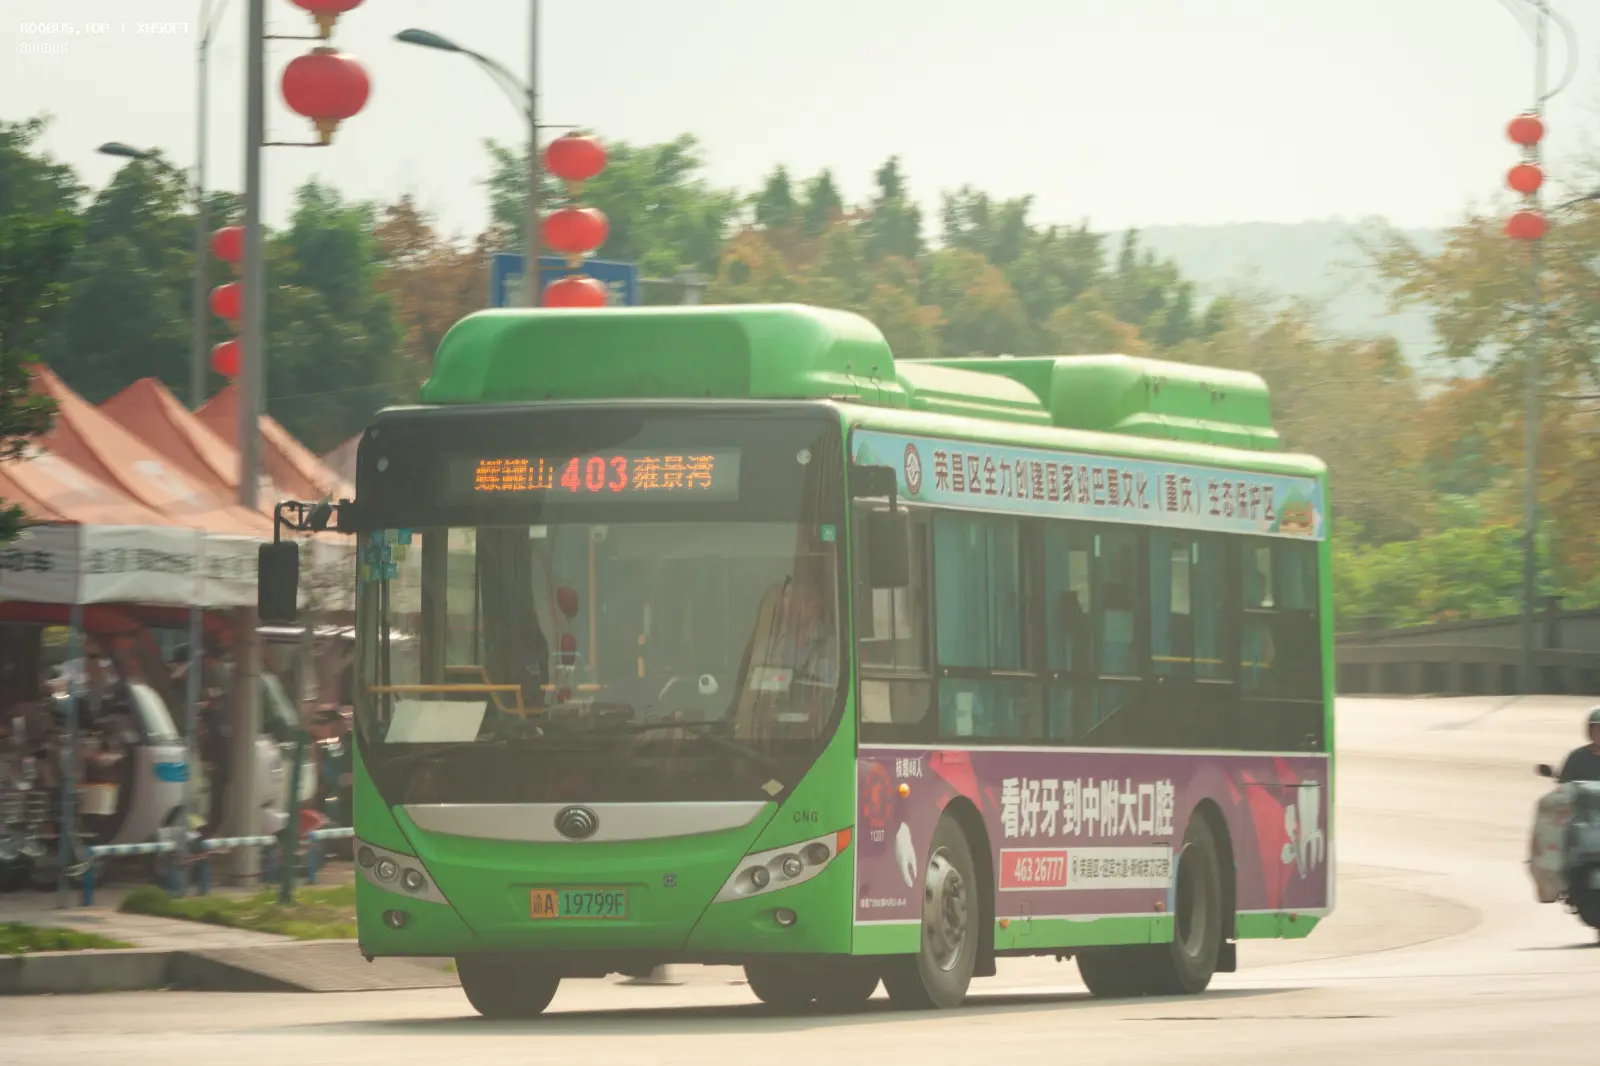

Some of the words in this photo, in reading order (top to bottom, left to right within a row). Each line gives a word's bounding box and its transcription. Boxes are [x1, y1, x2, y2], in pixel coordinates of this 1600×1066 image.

[561, 455, 627, 492] 403
[792, 810, 819, 824] CNG
[1001, 777, 1060, 839] 看好牙
[1014, 857, 1033, 882] 463
[1034, 856, 1065, 881] 26777
[532, 893, 554, 915] 渝A
[564, 893, 624, 915] 19799F
